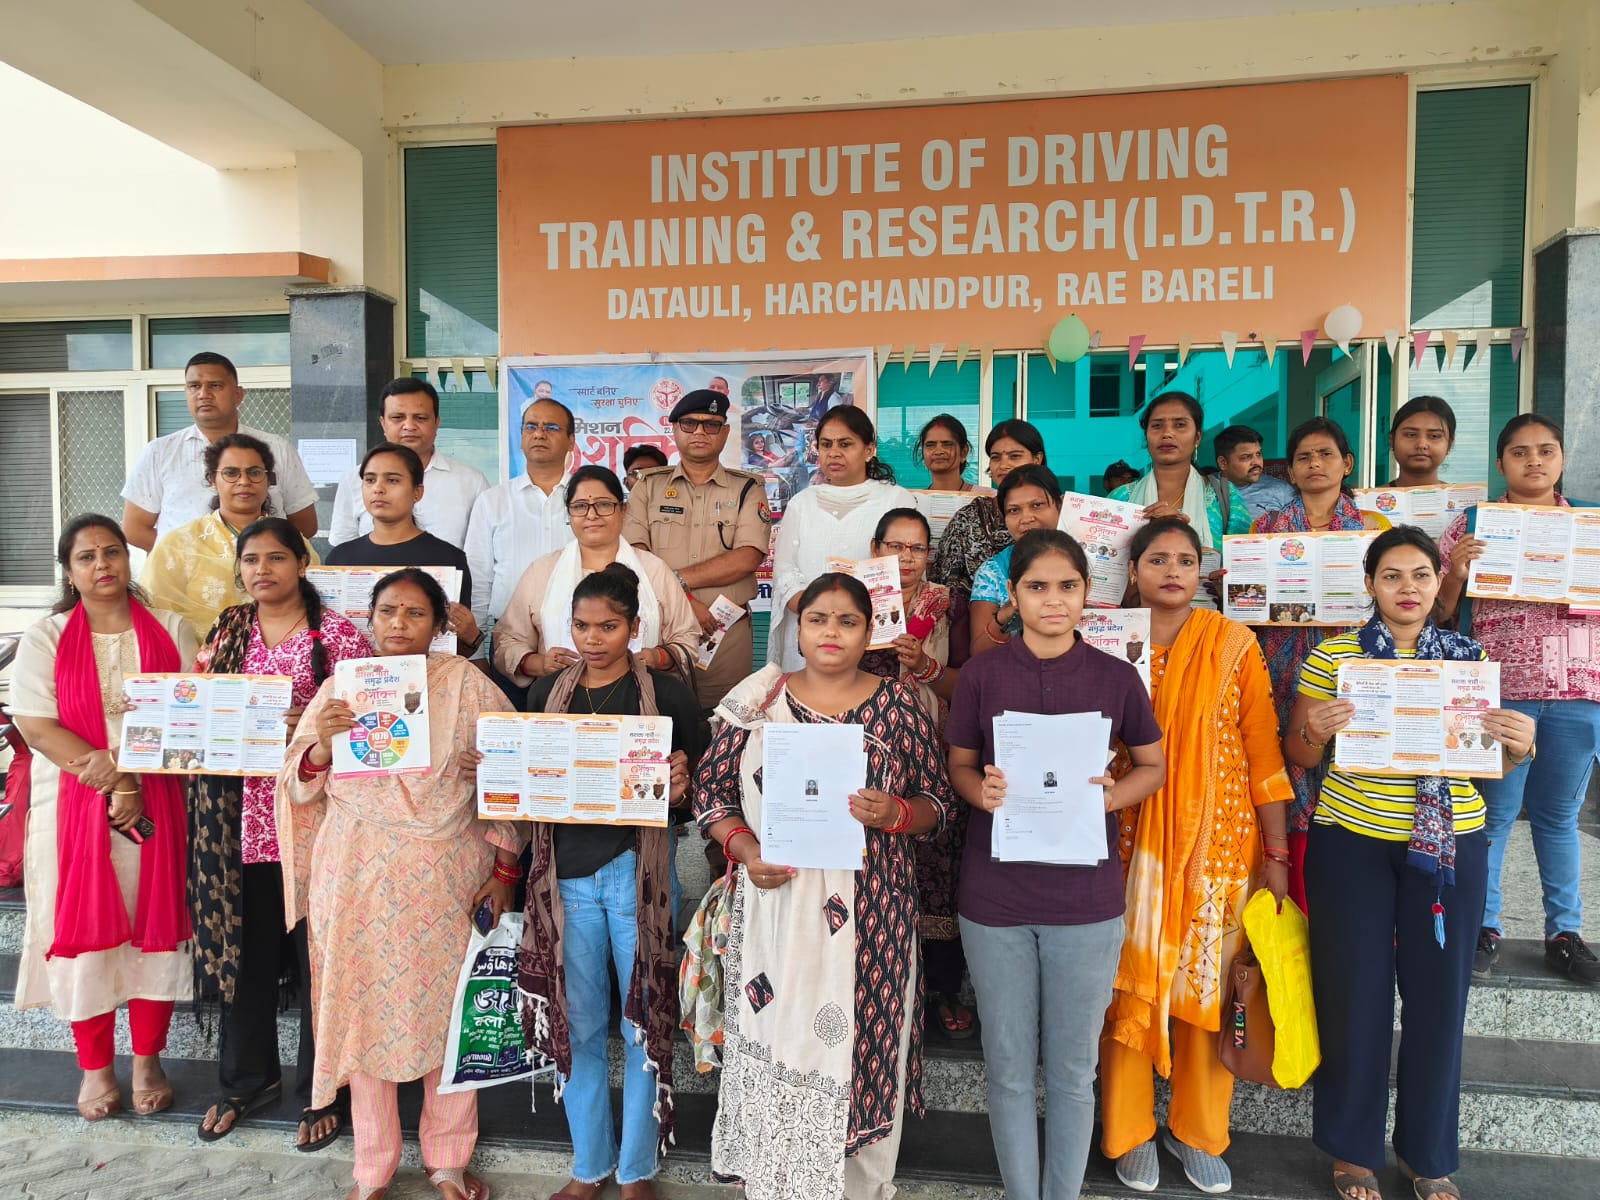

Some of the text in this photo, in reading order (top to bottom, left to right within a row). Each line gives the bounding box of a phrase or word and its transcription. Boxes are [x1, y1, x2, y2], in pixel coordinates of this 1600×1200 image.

[651, 125, 1228, 204] INSTITUTE OF DRIVING
[539, 188, 1356, 271] TRAINING & RESEARCH(I.D.T.R.)
[607, 266, 1275, 322] DATAULI, HARCHANDPUR, RAE BARELI
[572, 386, 595, 396] स्मार्ट
[593, 399, 616, 409] सुरक्षा
